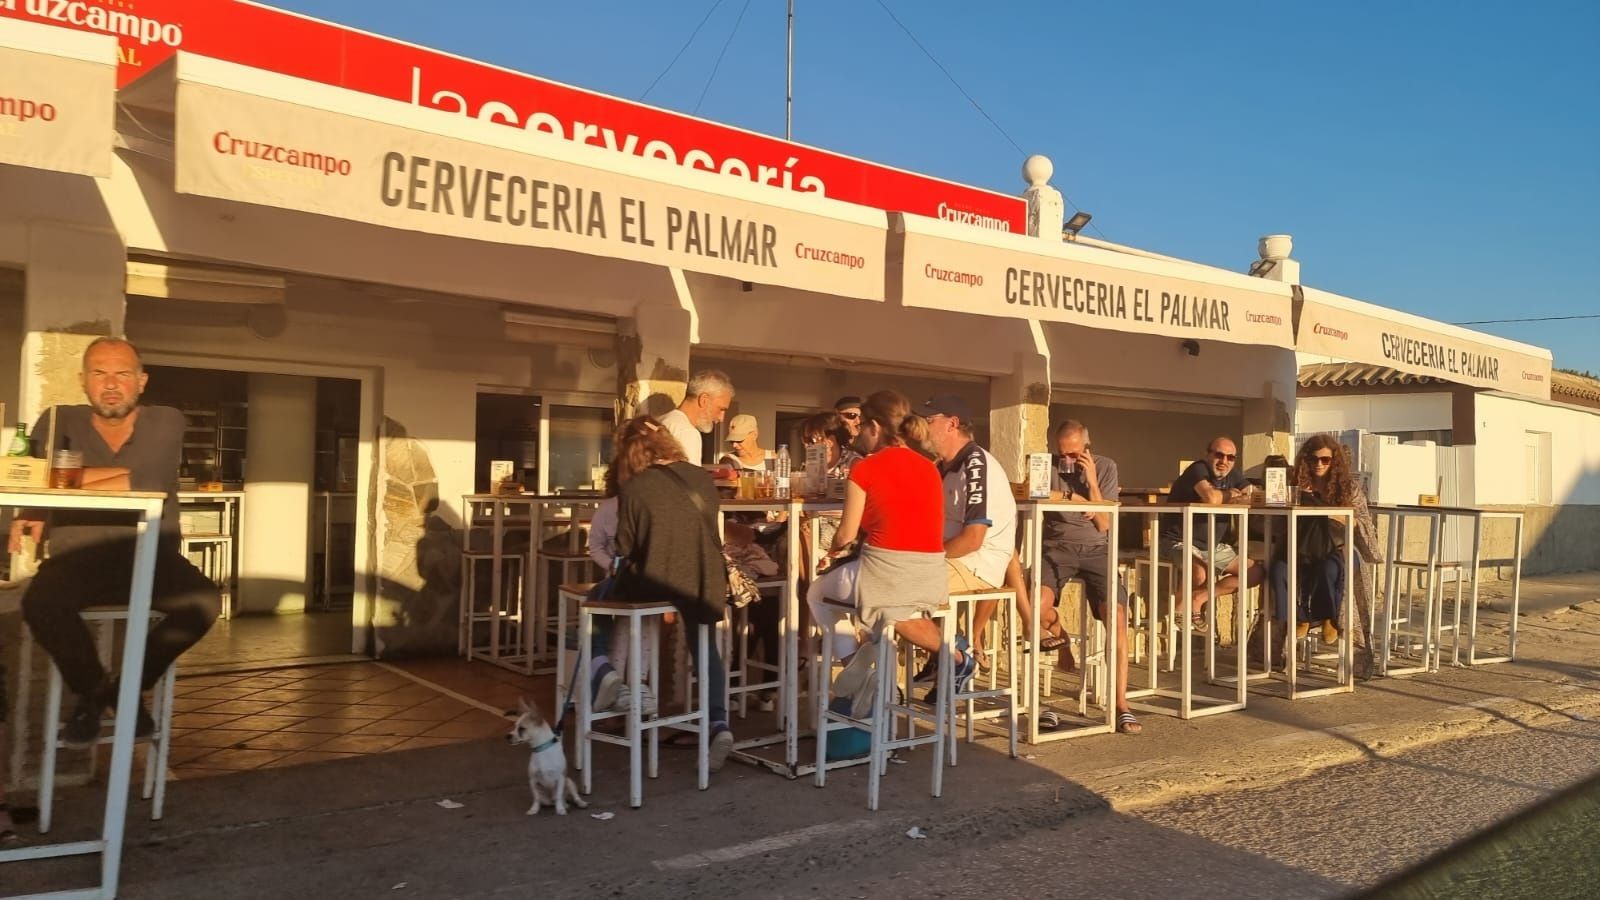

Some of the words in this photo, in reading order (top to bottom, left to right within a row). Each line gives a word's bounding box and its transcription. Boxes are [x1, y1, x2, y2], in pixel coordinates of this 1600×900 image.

[213, 130, 352, 177] Cruzcampo
[380, 150, 608, 240] CERVECERIA
[620, 197, 656, 248] EL
[667, 206, 779, 270] PALMAR
[795, 242, 865, 270] Cruzcampo
[924, 263, 984, 288] Cruzcampo
[1005, 266, 1127, 320] CERVECERIA
[1133, 288, 1155, 323] EL
[1161, 292, 1231, 332] PALMAR
[1381, 331, 1447, 371] CERVECERIA
[1448, 348, 1459, 374] EL
[1461, 351, 1499, 382] PALMAR
[966, 451, 985, 505] SAILS
